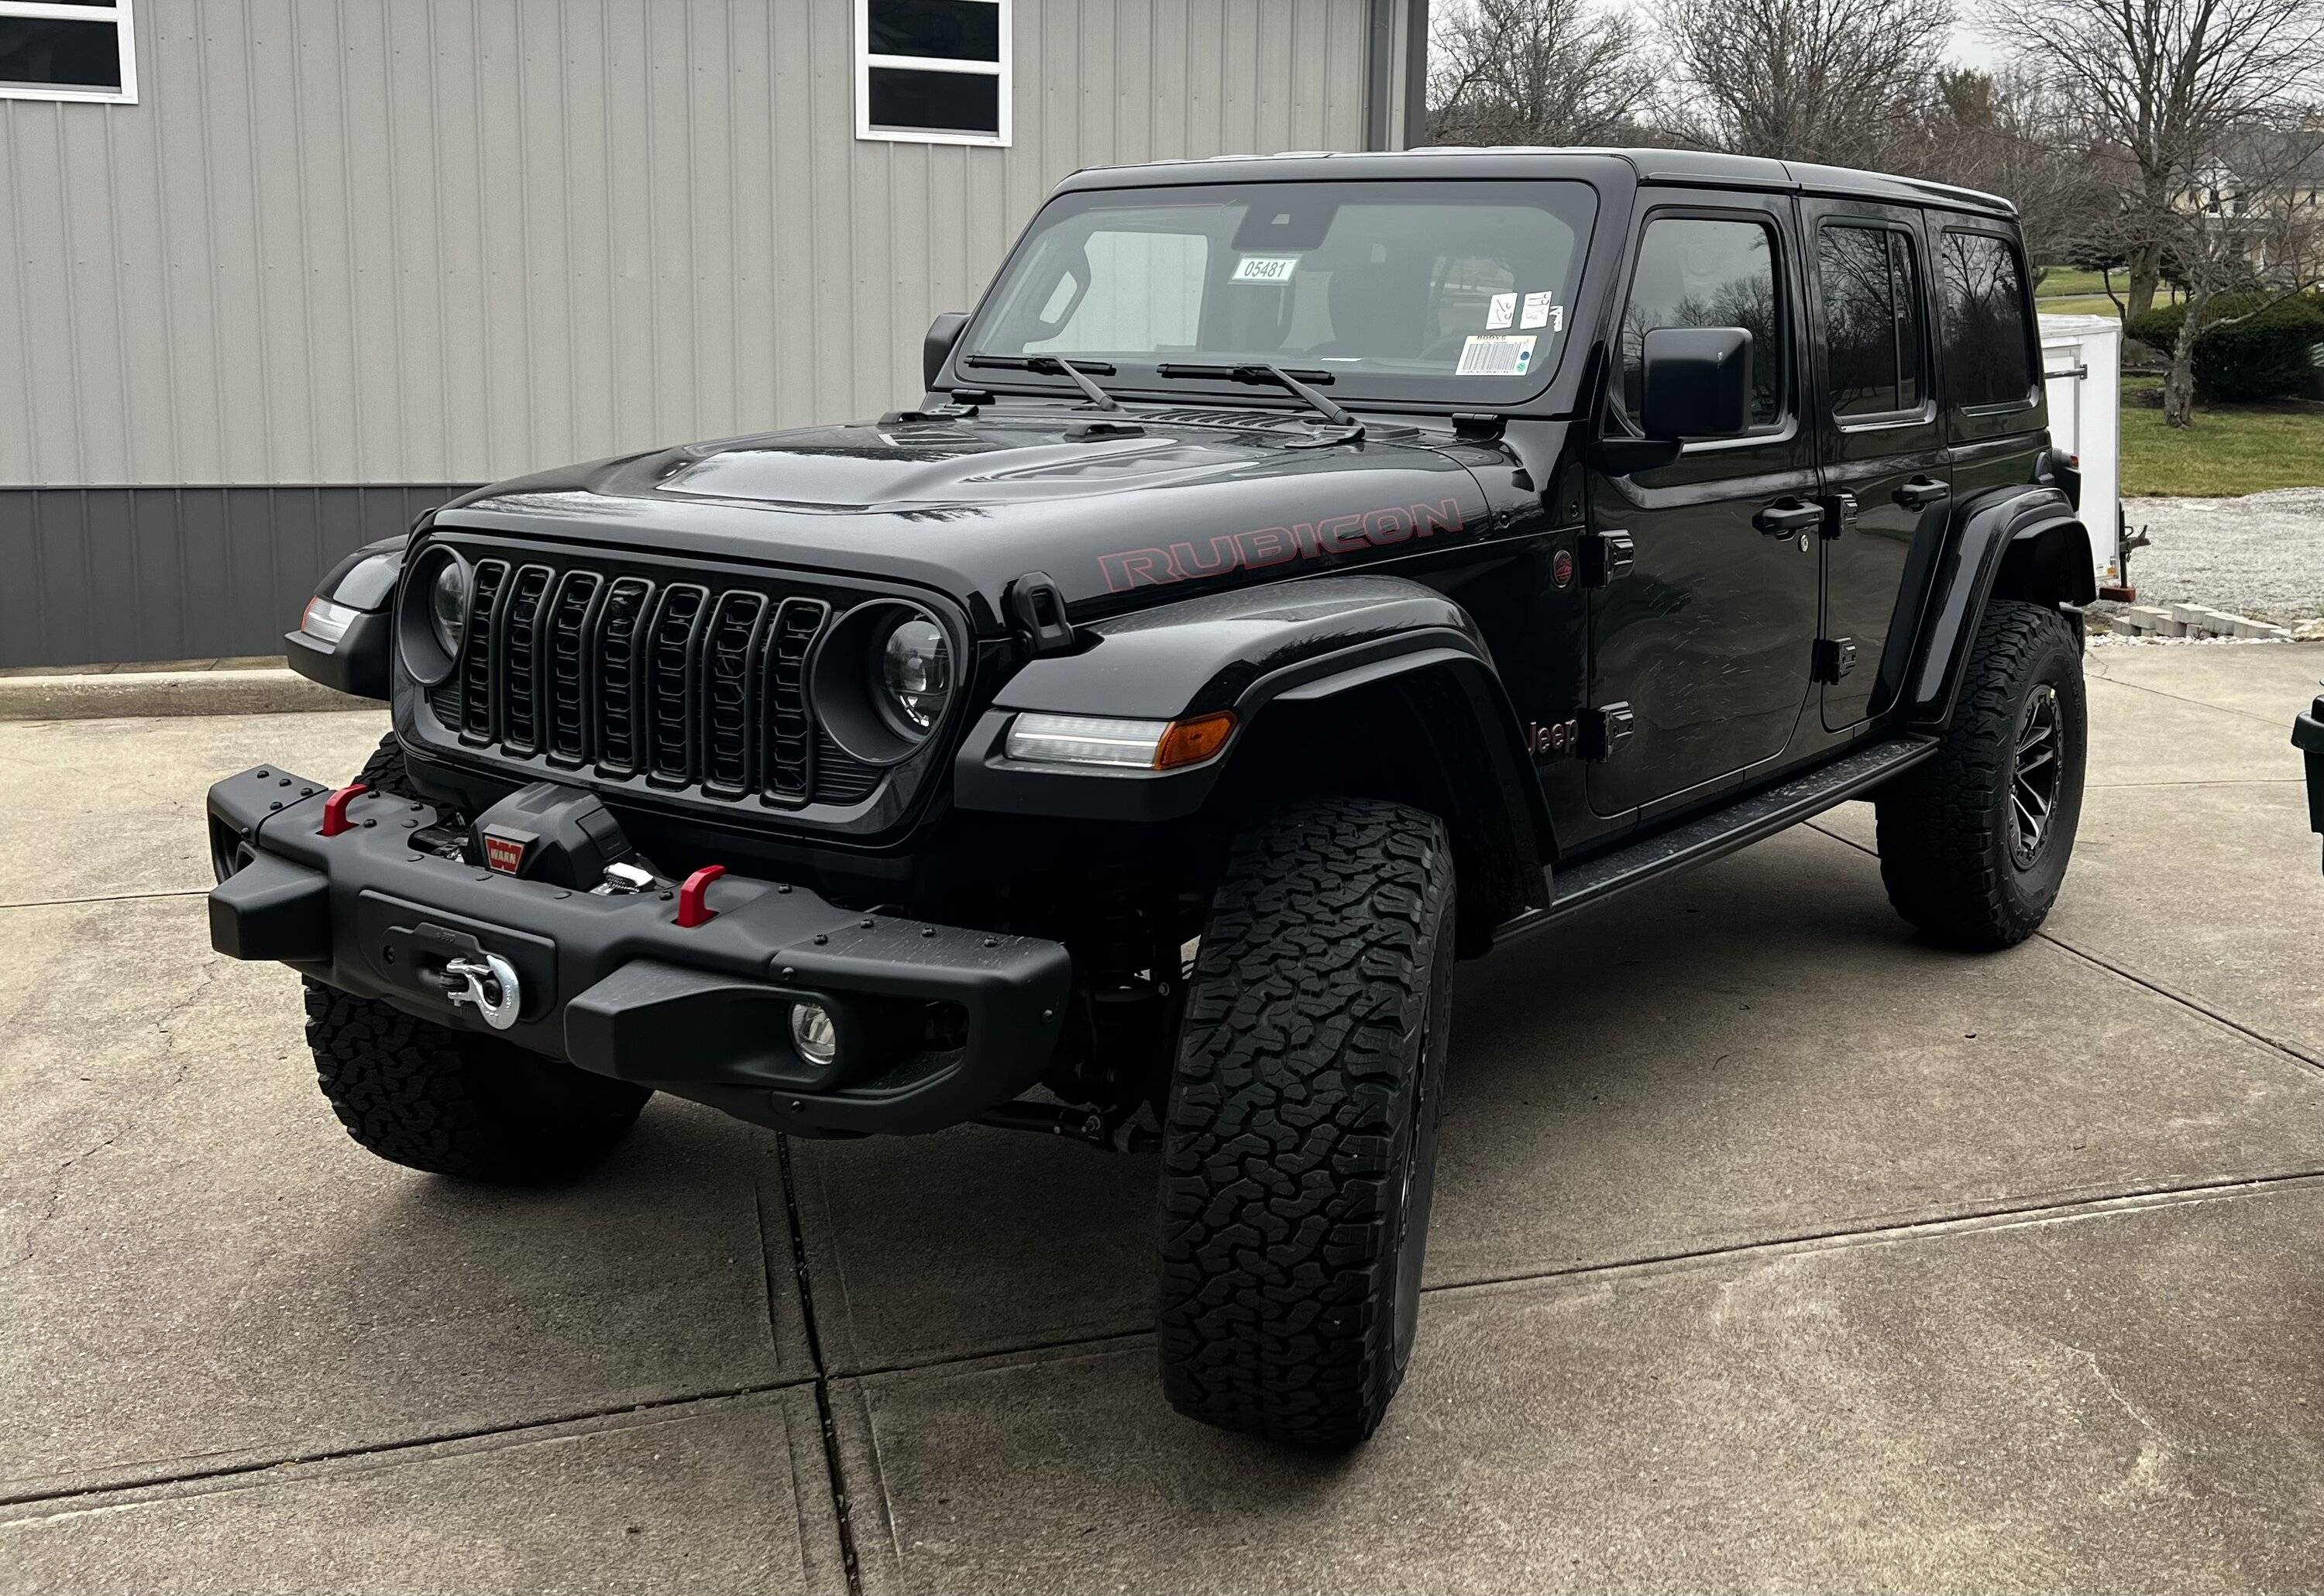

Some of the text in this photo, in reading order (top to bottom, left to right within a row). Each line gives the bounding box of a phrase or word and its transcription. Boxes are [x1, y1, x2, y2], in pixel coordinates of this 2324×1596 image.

[1243, 260, 1286, 277] 05481
[1098, 498, 1464, 592] RUBICON
[1527, 718, 1579, 757] Jeep
[490, 848, 517, 865] WARN
